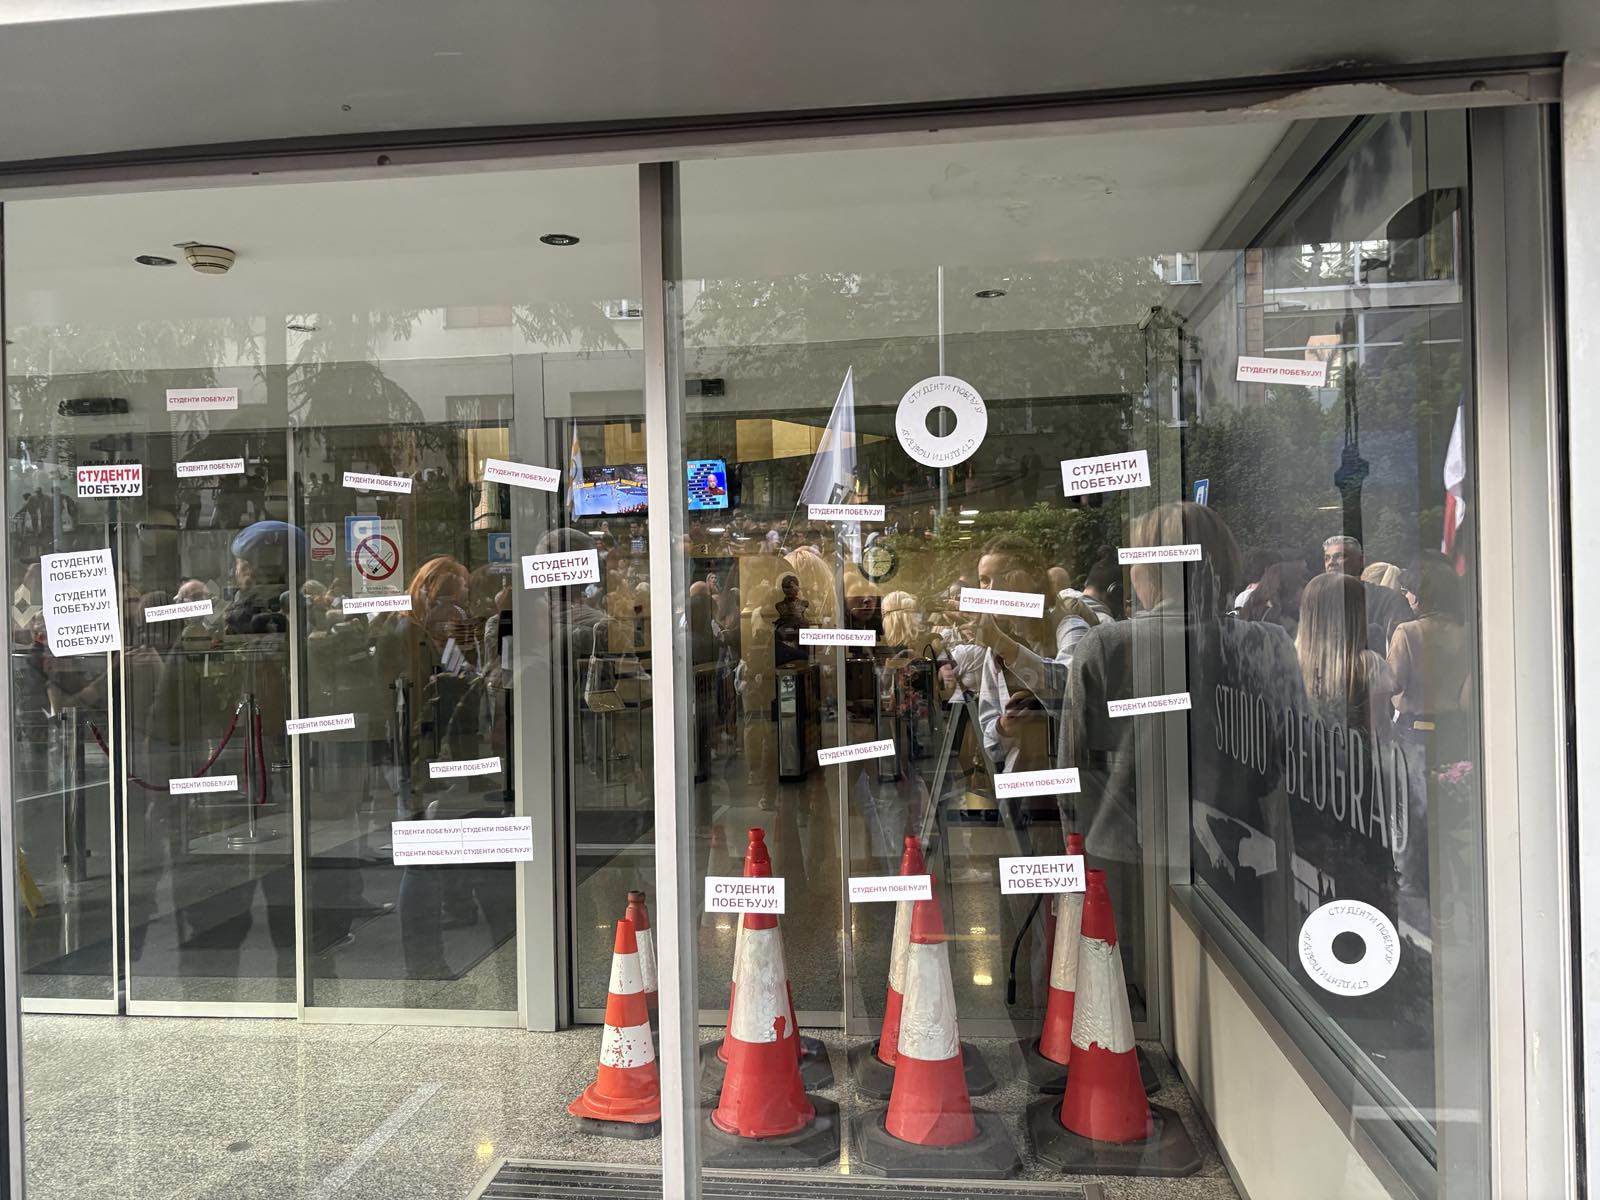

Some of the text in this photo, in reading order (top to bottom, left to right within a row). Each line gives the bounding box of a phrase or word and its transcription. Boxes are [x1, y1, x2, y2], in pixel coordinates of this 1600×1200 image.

[1239, 365, 1322, 376] СТУДЕНТИ ПОБЕЂУЈУ!
[200, 393, 234, 402] ПОБЕЂУЈУ!
[907, 382, 952, 405] СТУДЕНТИ
[178, 461, 242, 472] СТУДЕНТИ ПОБЕЂУЈУ!
[1072, 458, 1137, 476] СТУДЕНТИ
[78, 468, 139, 483] СТУДЕНТИ
[487, 466, 556, 483] СТУДЕНТИ ПОБЕЂУЈУ!
[1070, 472, 1142, 490] ПОБЕЂУЈУ!
[78, 482, 140, 494] ПОБЕЂУЈУ
[344, 475, 410, 488] СТУДЕНТИ ПОБЕЂУЈУ!
[809, 507, 843, 515] СТУДЕНТИ
[1119, 548, 1199, 559] СТУДЕНТИ ПОБЕЂУЈУ!
[50, 555, 103, 568] СТУДЕНТИ
[531, 556, 588, 570] СТУДЕНТИ
[49, 566, 107, 581] ПОБЕЂУЈУ!
[530, 569, 592, 584] ПОБЕЂУЈУ!
[54, 588, 106, 602] СТУДЕНТИ
[52, 600, 110, 615] ПОБЕЂУЈУ!
[344, 600, 374, 608] СТУДЕНТИ
[962, 596, 1041, 609] СТУДЕНТИ ПОБЕЂУЈУ!
[146, 607, 176, 617] СТУДЕНТИ
[57, 621, 110, 635] СТУДЕНТИ
[56, 633, 113, 648] ПОБЕЂУЈУ!
[800, 632, 834, 640] СТУДЕНТИ
[1109, 696, 1188, 712] СТУДЕНТИ ПОБЕЂУЈУ!
[288, 720, 318, 730] СТУДЕНТИ
[819, 743, 892, 760] СТУДЕНТИ ПОБЕЂУЈУ!
[430, 764, 462, 773] СТУДЕНТИ
[1215, 684, 1410, 854] STUDIO BEOGRAD
[170, 781, 201, 789] СТУДЕНТИ
[997, 777, 1075, 789] СТУДЕНТИ ПОБЕЂУЈУ!
[1010, 862, 1074, 875] СТУДЕНТИ
[1008, 876, 1078, 888] ПОБЕЂУЈУ!
[714, 883, 774, 895] СТУДЕНТИ
[851, 885, 887, 893] СТУДЕНТИ
[712, 897, 777, 908] ПОБЕЂУЈУ!
[1328, 906, 1378, 924] СТУДЕНТИ
